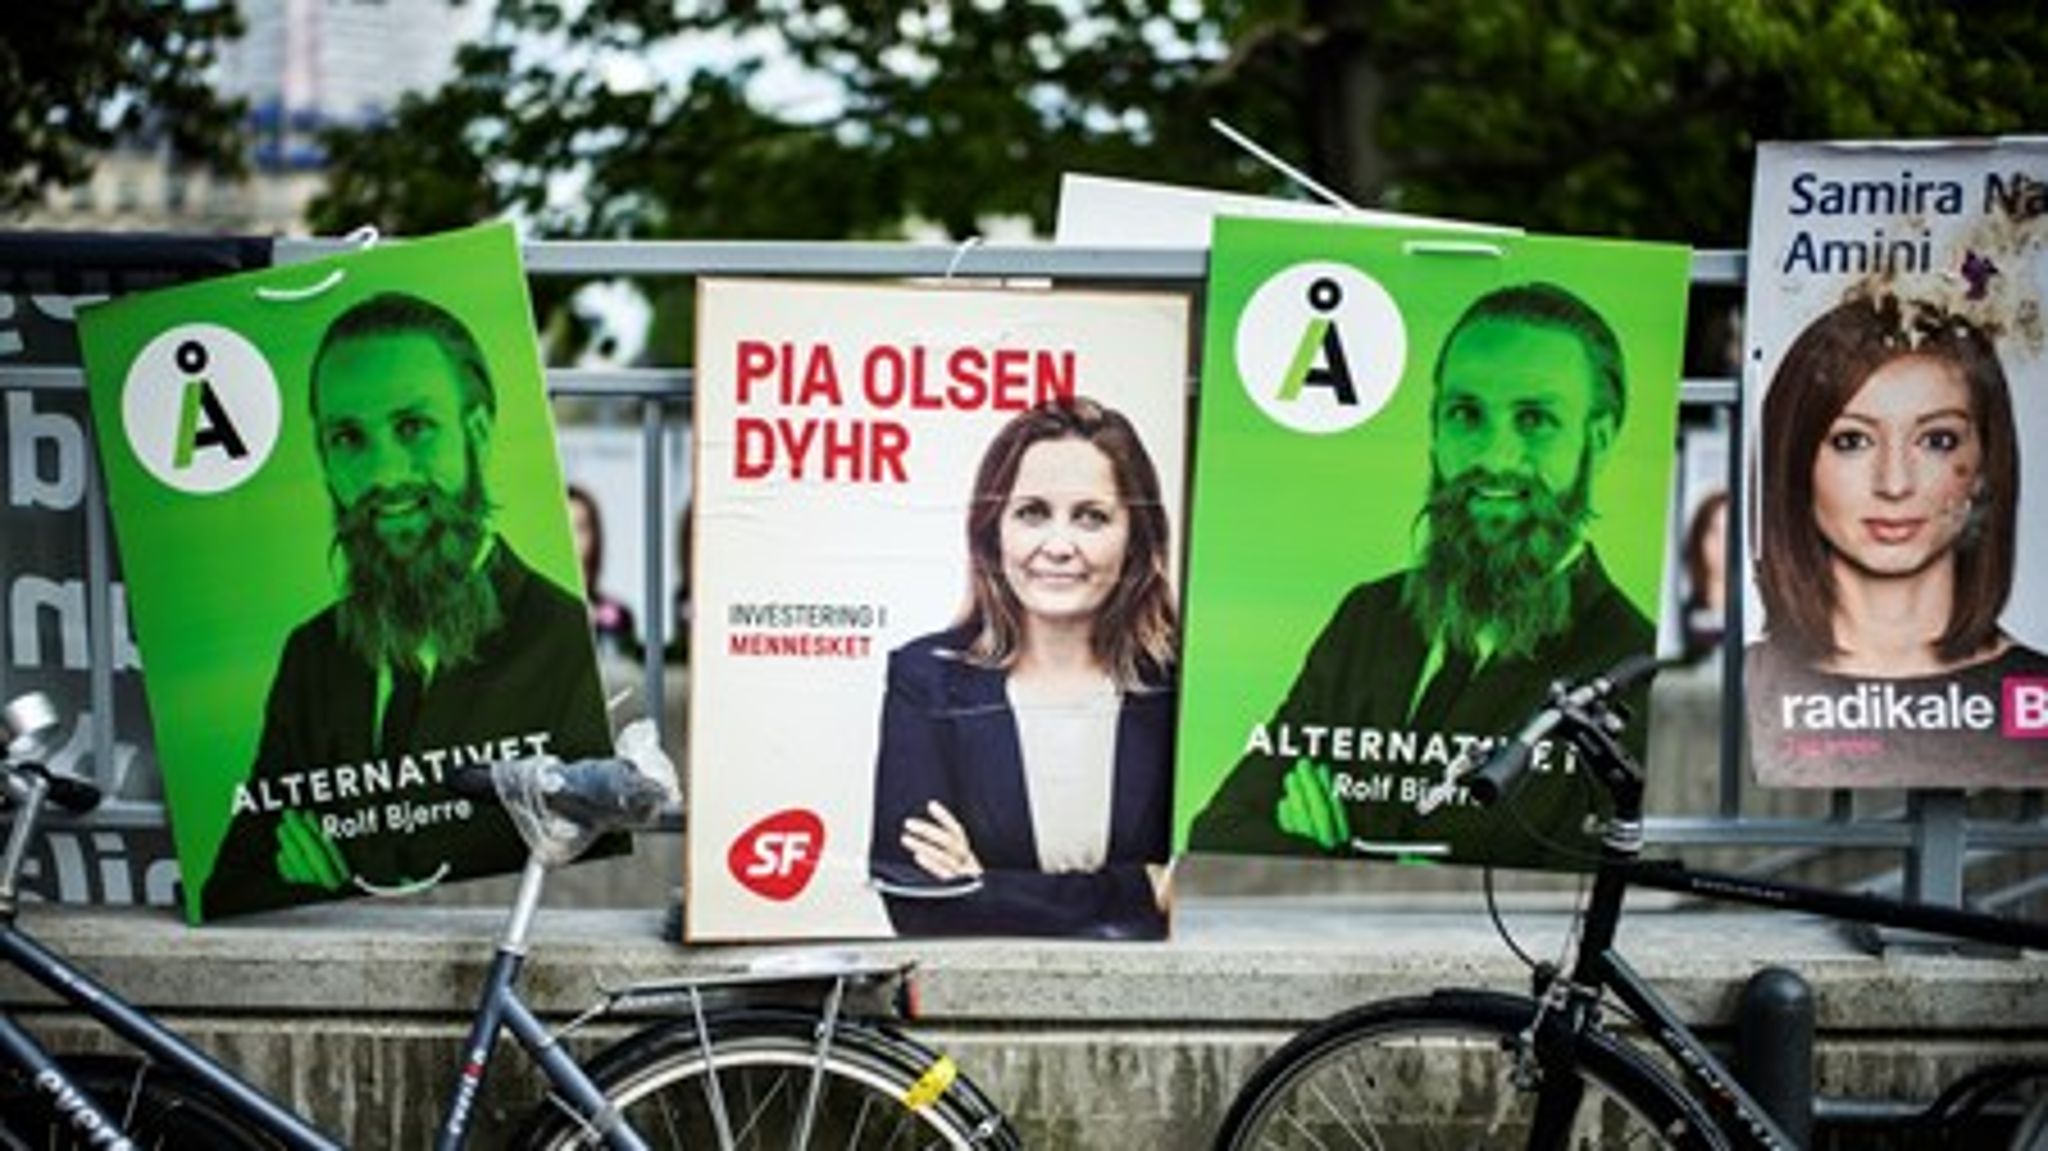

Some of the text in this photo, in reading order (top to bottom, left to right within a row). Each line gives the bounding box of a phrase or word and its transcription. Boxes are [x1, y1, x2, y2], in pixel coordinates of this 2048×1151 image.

[1788, 171, 1963, 216] Samira
[1783, 228, 1932, 274] Amini
[1274, 276, 1359, 407] Å
[735, 340, 1076, 412] PIA OLSEN
[172, 340, 250, 469] Å
[734, 417, 911, 483] DYHR
[728, 603, 874, 628] INVESTERING
[728, 632, 874, 658] MENNESKET
[1781, 681, 1996, 730] radikale
[1331, 771, 1395, 802] Rolf
[321, 804, 380, 840] Rolf
[745, 831, 812, 877] SF
